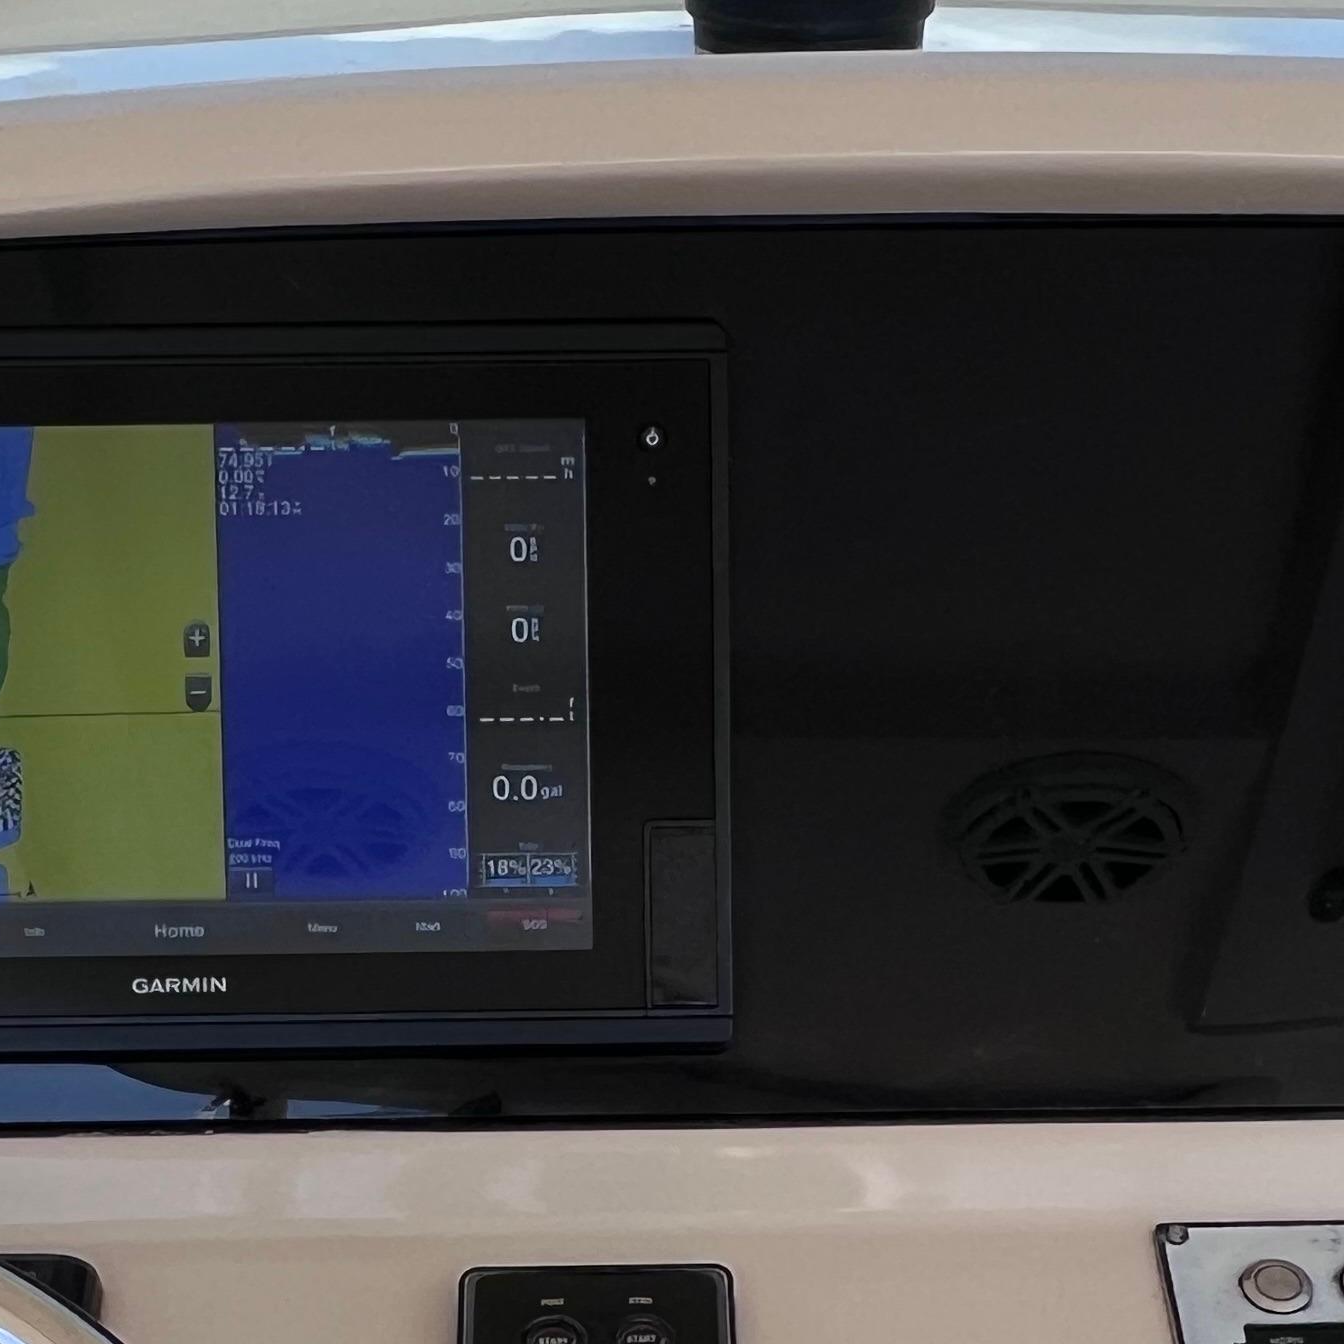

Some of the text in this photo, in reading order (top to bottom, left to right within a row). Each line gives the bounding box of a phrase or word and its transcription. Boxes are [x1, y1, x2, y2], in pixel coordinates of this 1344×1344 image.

[492, 775, 563, 801] 0.0 gal
[487, 858, 572, 877] 18% 23%
[154, 924, 205, 939] Home
[131, 976, 228, 995] GARMIN
